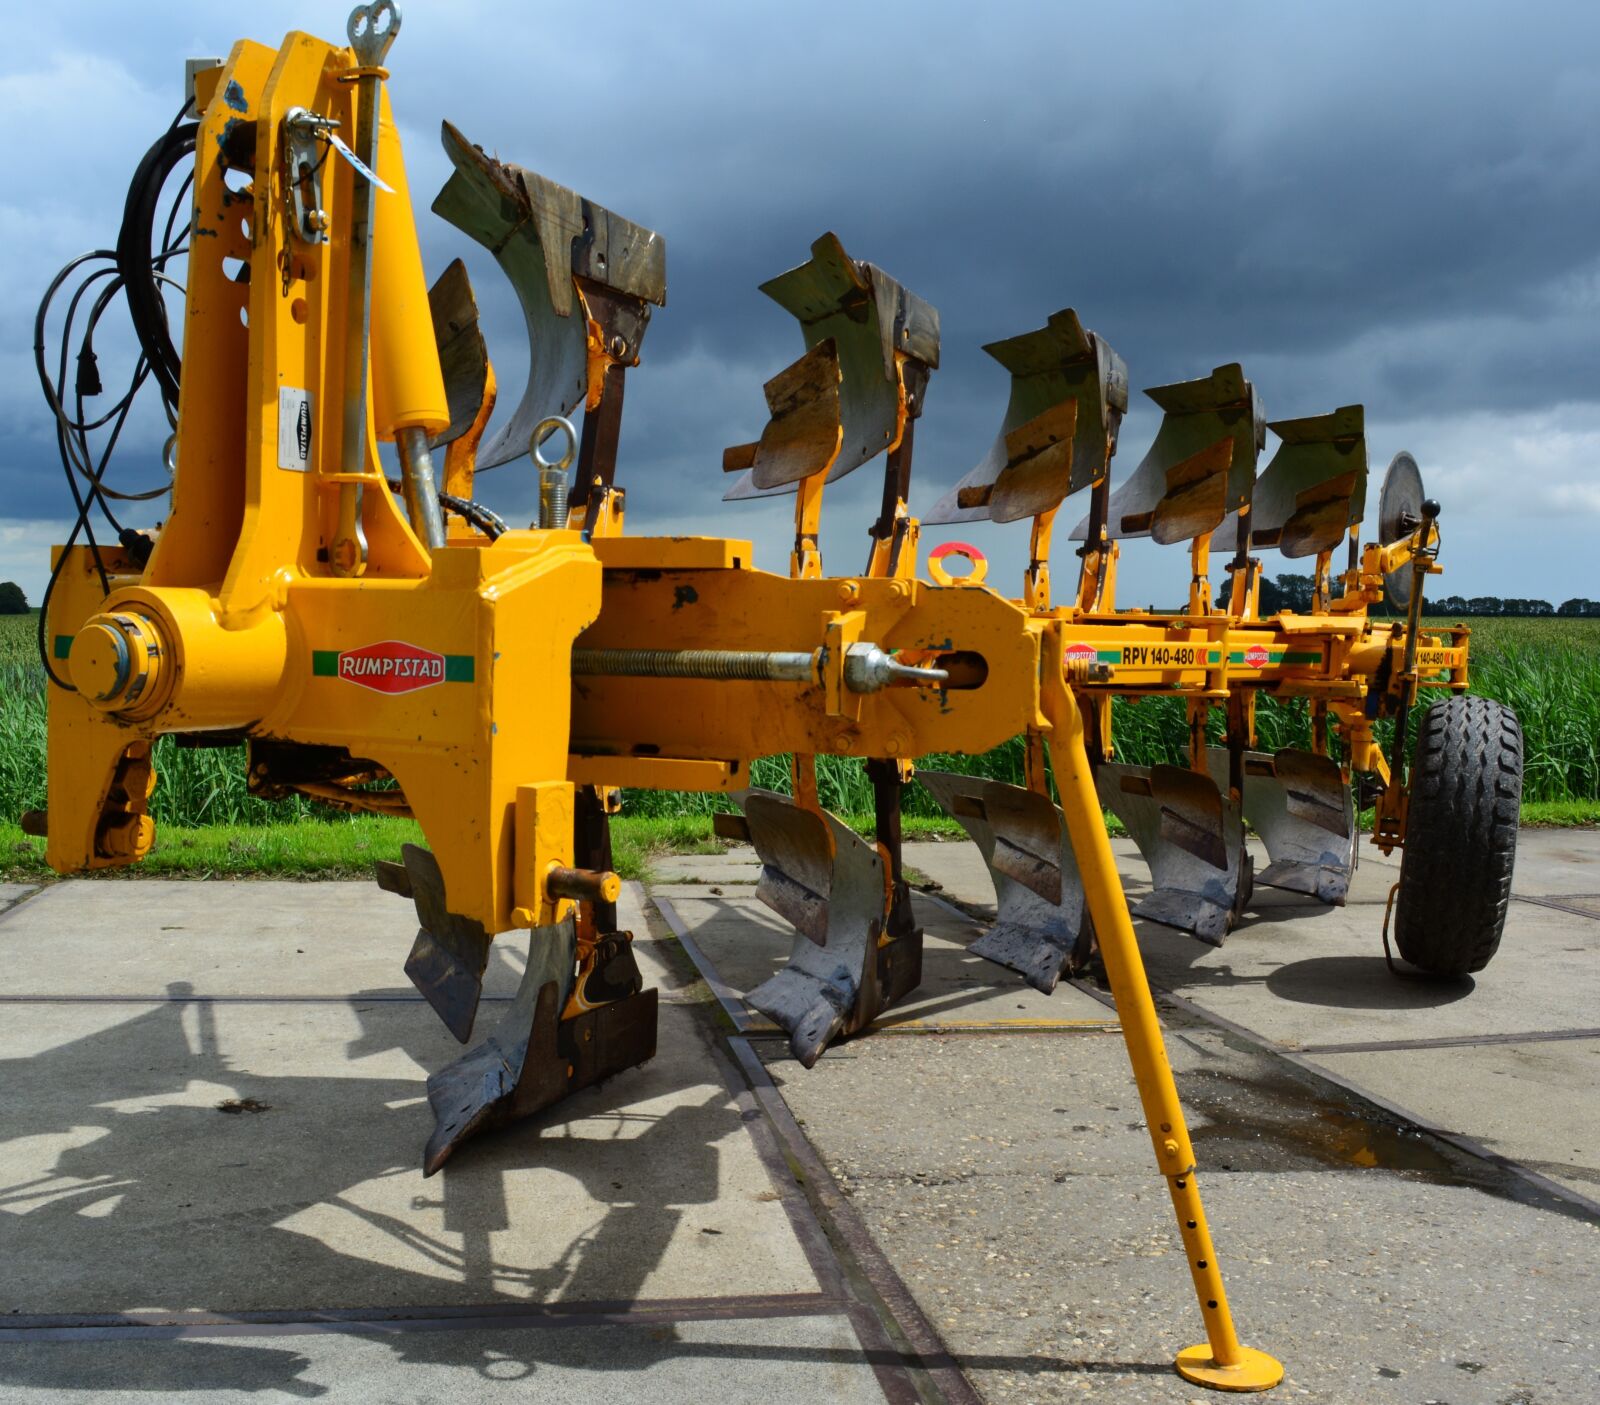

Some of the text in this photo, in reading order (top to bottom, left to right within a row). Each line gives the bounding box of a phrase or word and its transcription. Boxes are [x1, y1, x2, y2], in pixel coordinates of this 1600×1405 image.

[1123, 647, 1194, 664] RPV 140-480
[1420, 652, 1443, 664] 140-480
[342, 656, 441, 677] RUMPTSTAD
